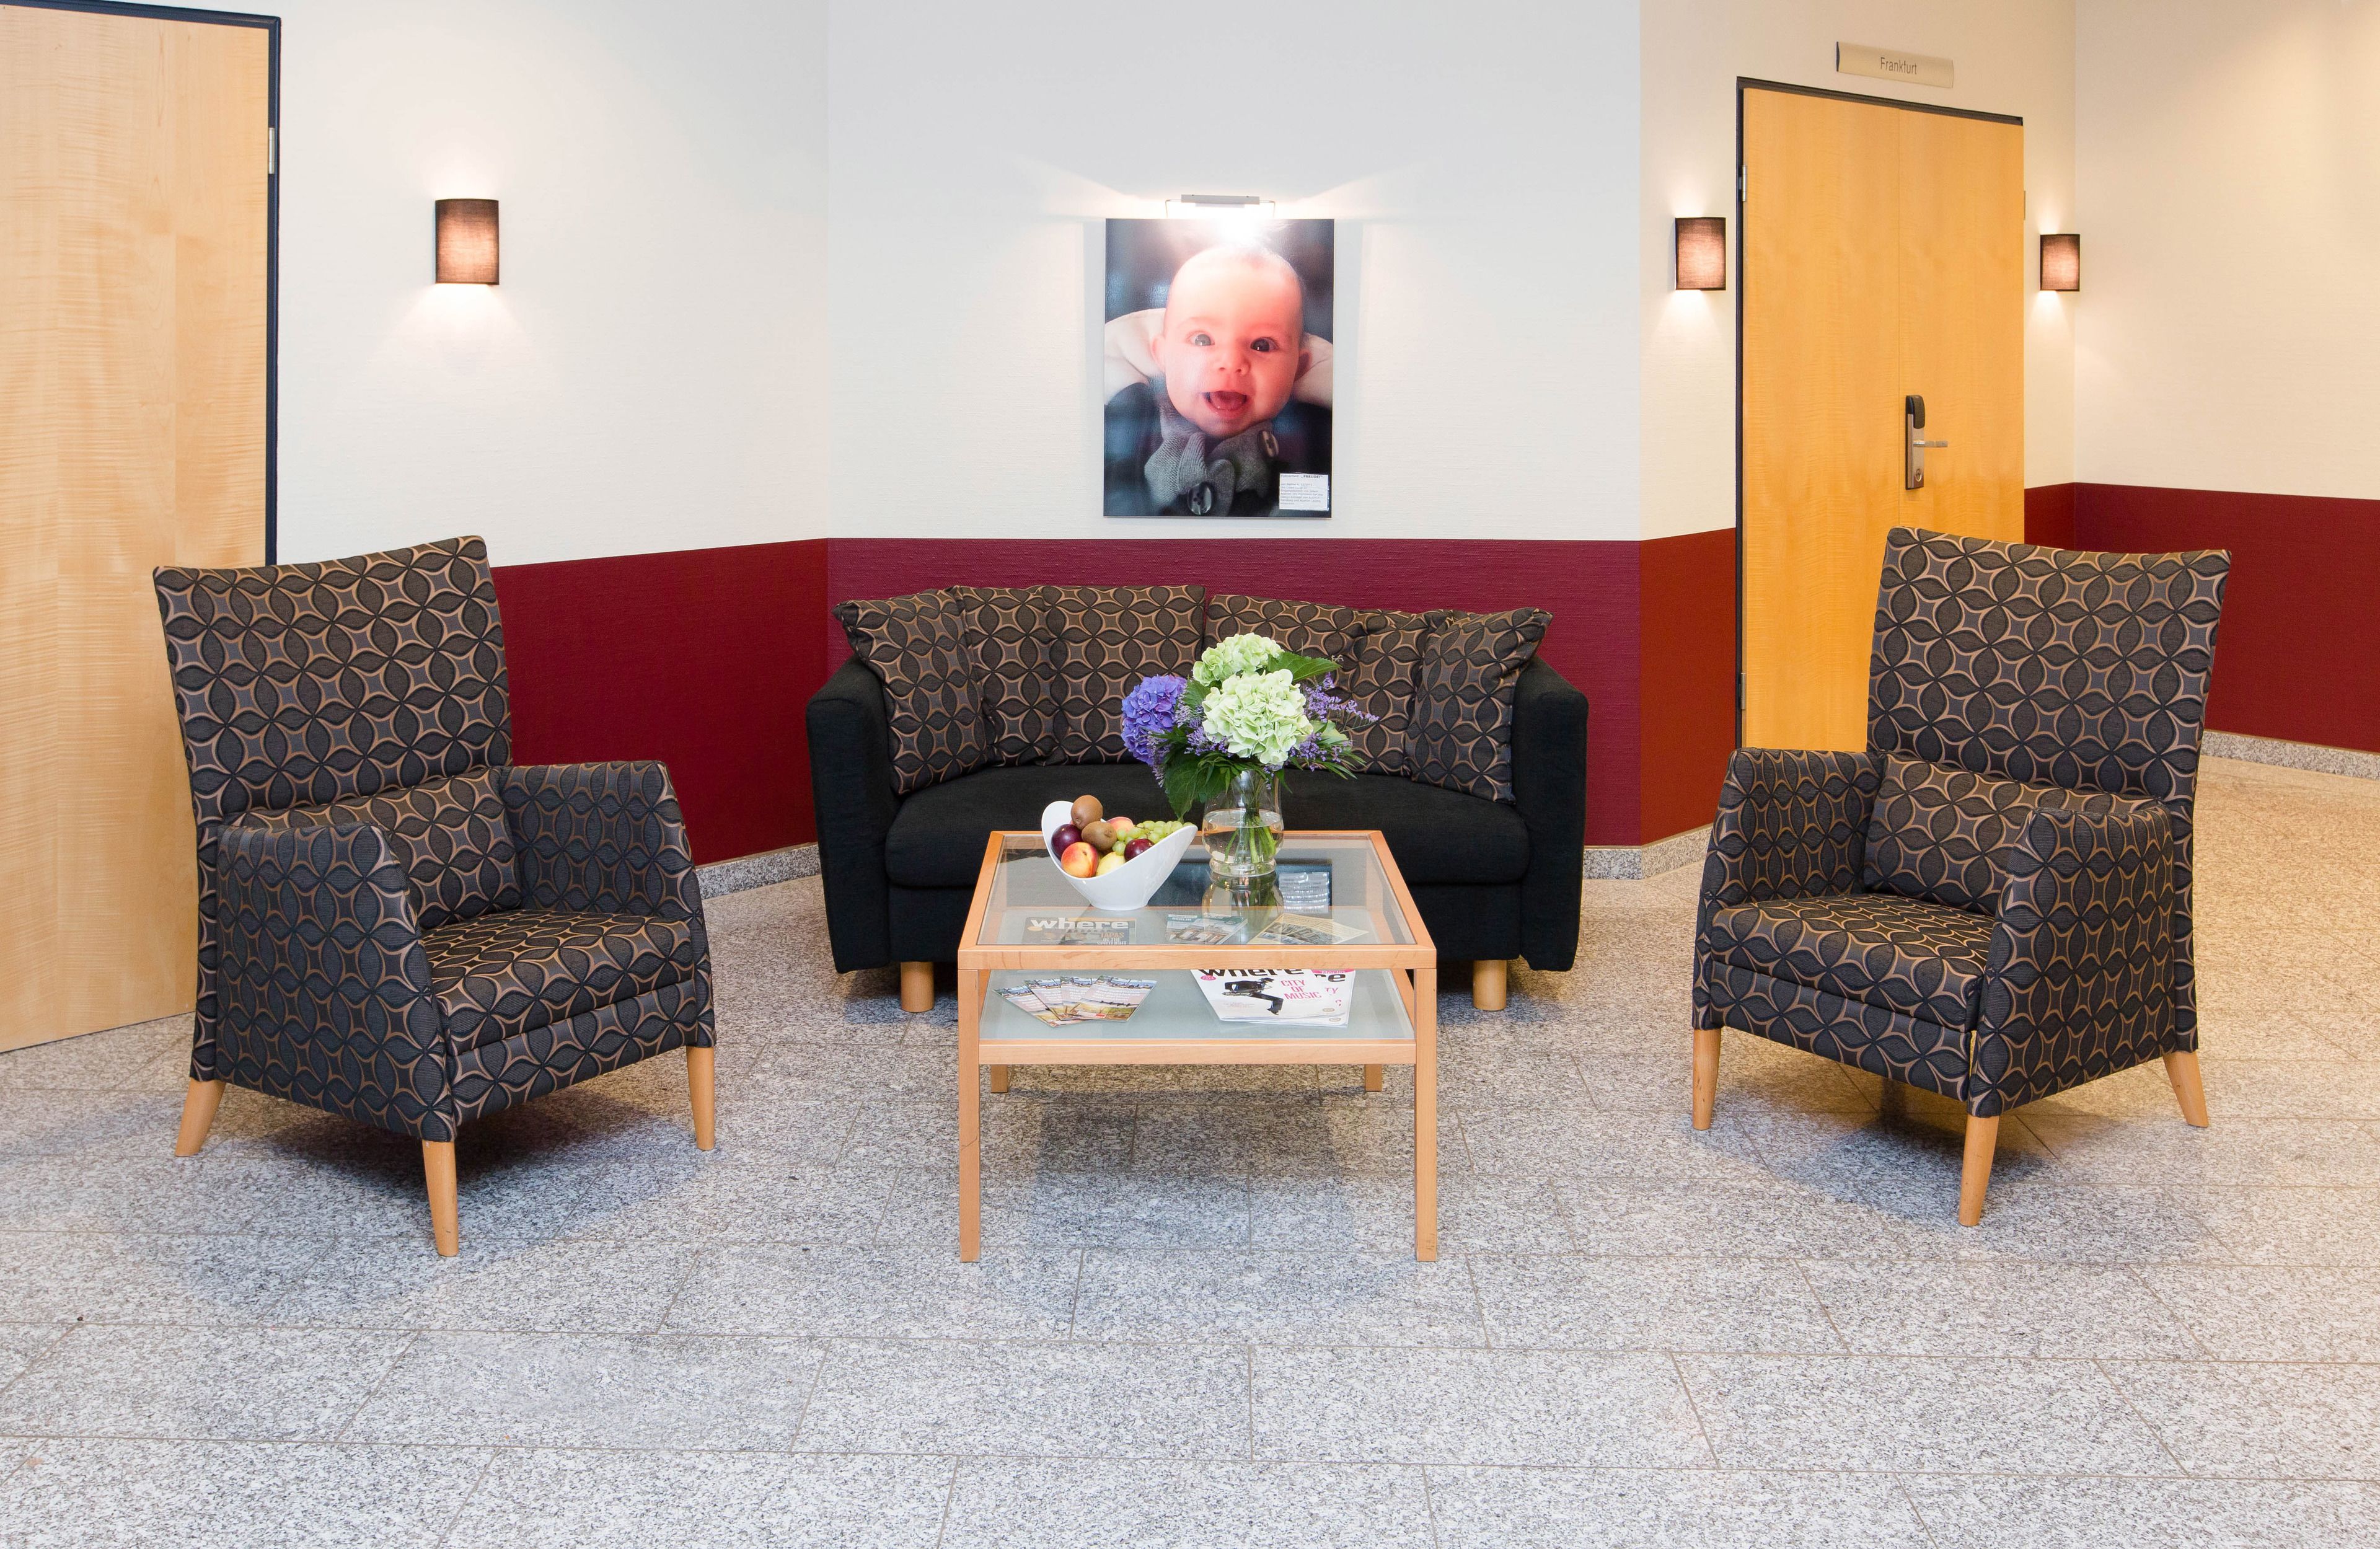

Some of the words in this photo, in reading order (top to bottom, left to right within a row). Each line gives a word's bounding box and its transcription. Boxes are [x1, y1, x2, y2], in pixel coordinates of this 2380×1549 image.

[1880, 57, 1917, 75] Frankfurt
[1031, 917, 1129, 929] where
[1284, 992, 1322, 1000] MUSIC
